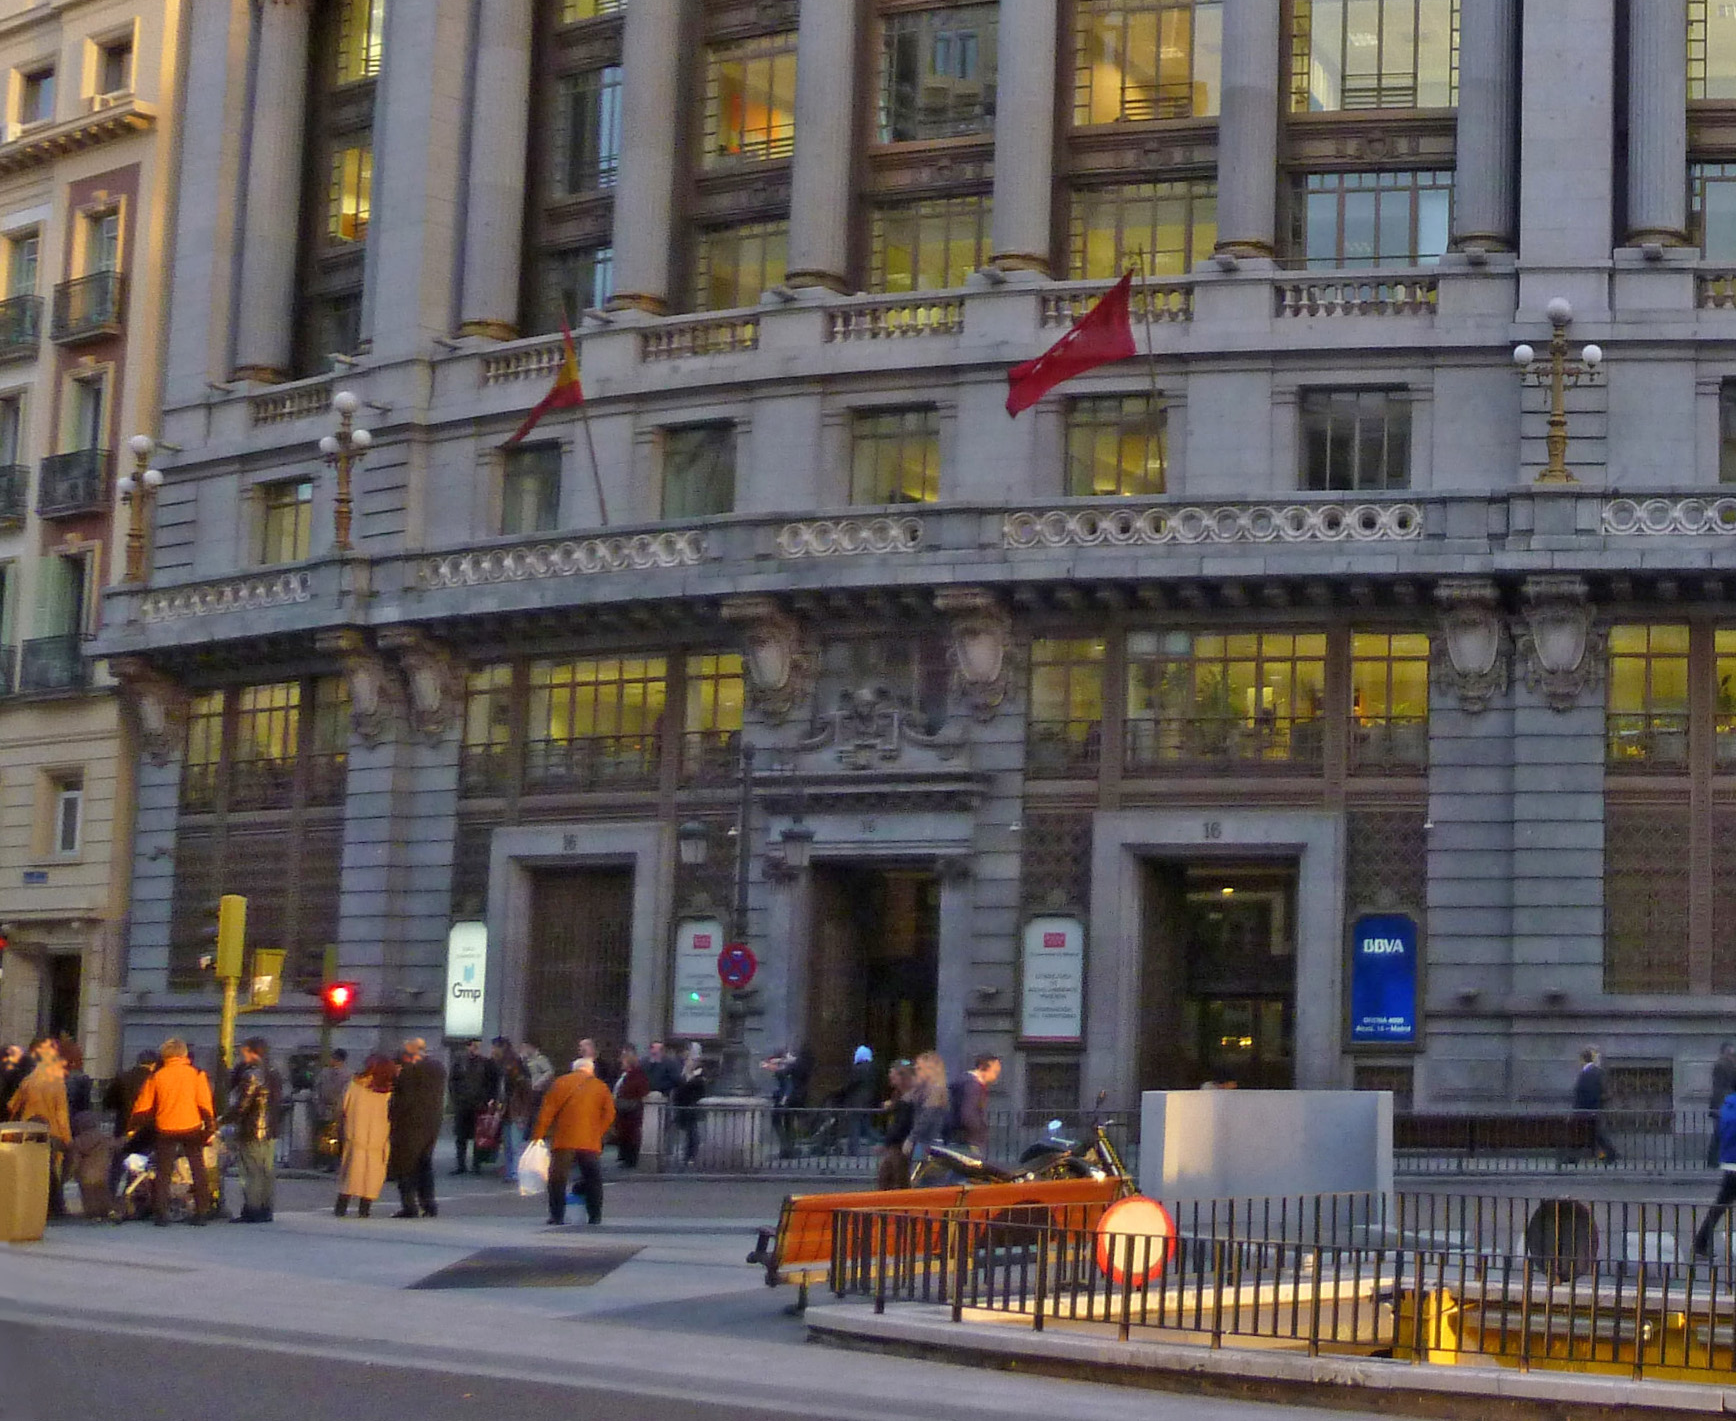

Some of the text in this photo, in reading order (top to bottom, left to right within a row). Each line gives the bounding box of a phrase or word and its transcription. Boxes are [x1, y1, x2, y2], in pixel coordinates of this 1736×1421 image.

[1202, 821, 1222, 839] 16
[1363, 938, 1405, 953] BBVA
[452, 982, 481, 1003] Gmp
